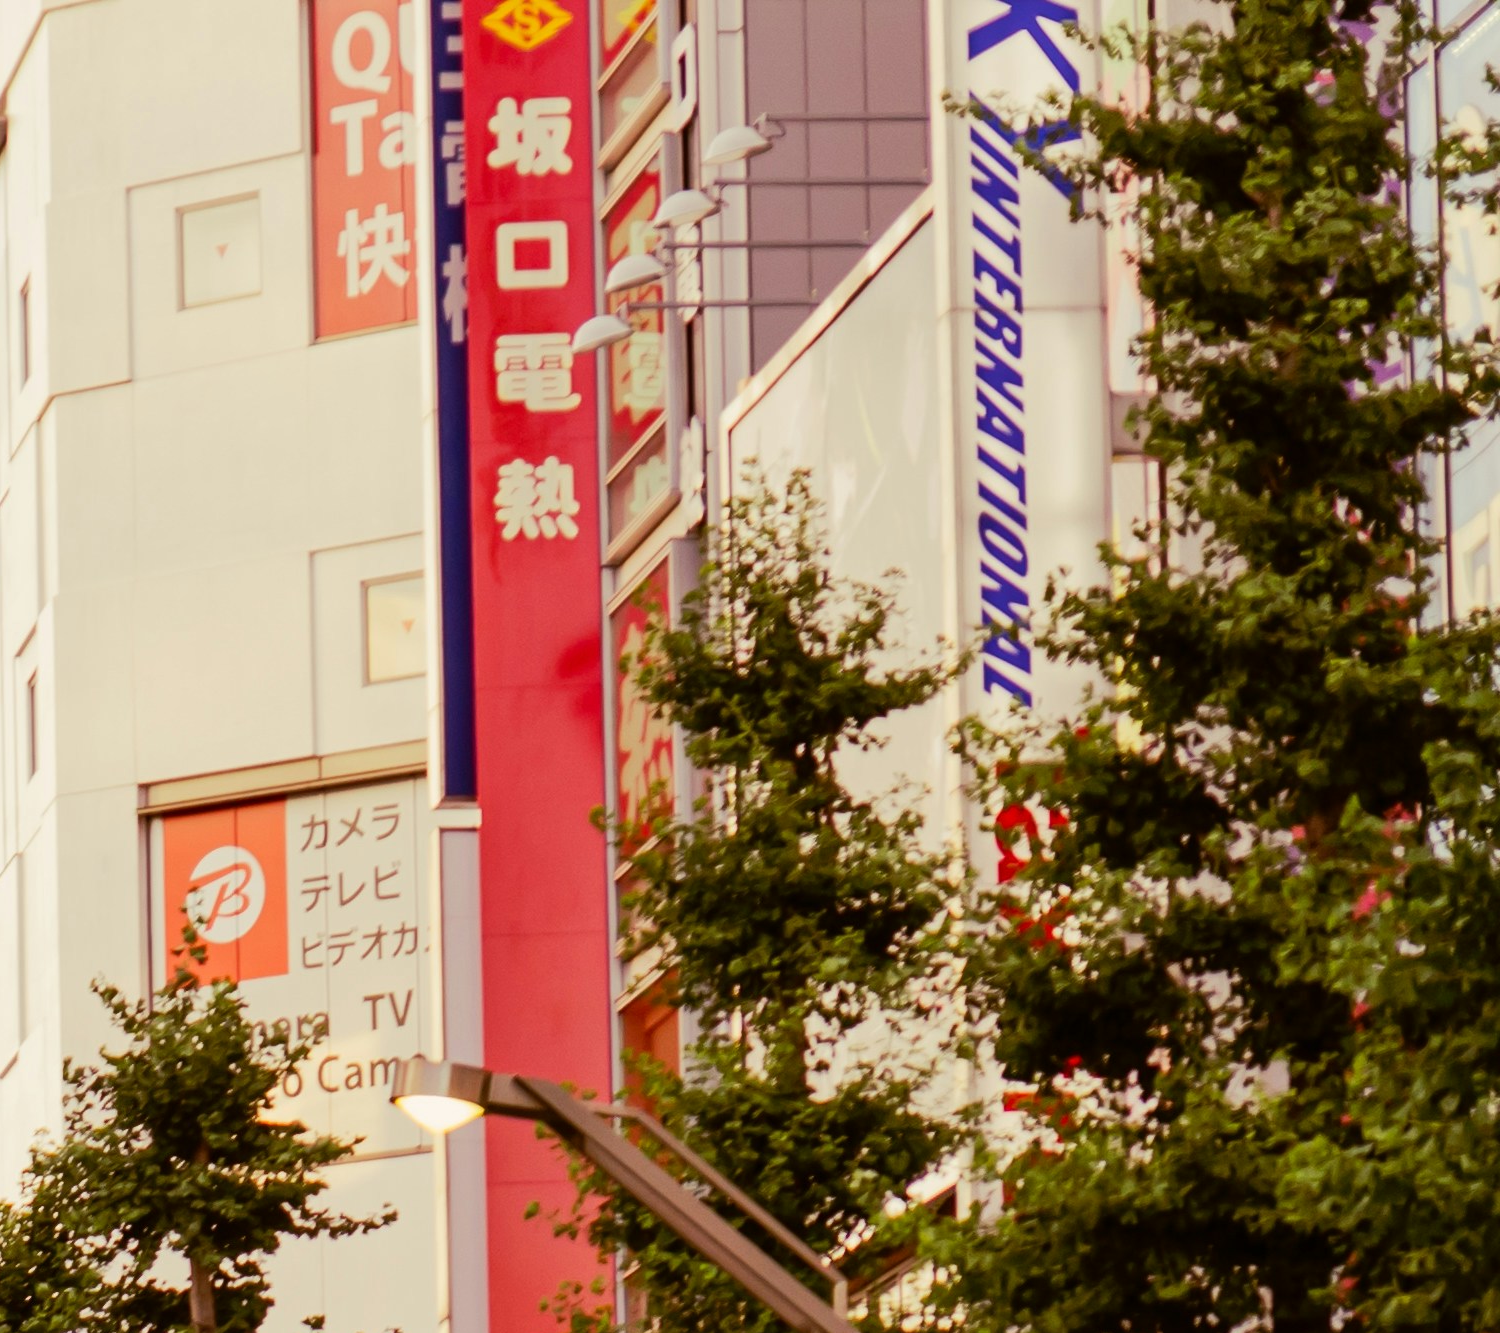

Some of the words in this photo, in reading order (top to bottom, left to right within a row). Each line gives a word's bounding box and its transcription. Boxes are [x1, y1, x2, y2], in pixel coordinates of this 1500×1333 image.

[330, 10, 416, 95] Q
[487, 96, 581, 541] 坂口電熱
[300, 803, 400, 853] カメラ
[300, 861, 400, 913] テレビ
[301, 921, 430, 970] ビデオカ
[363, 989, 415, 1031] TV
